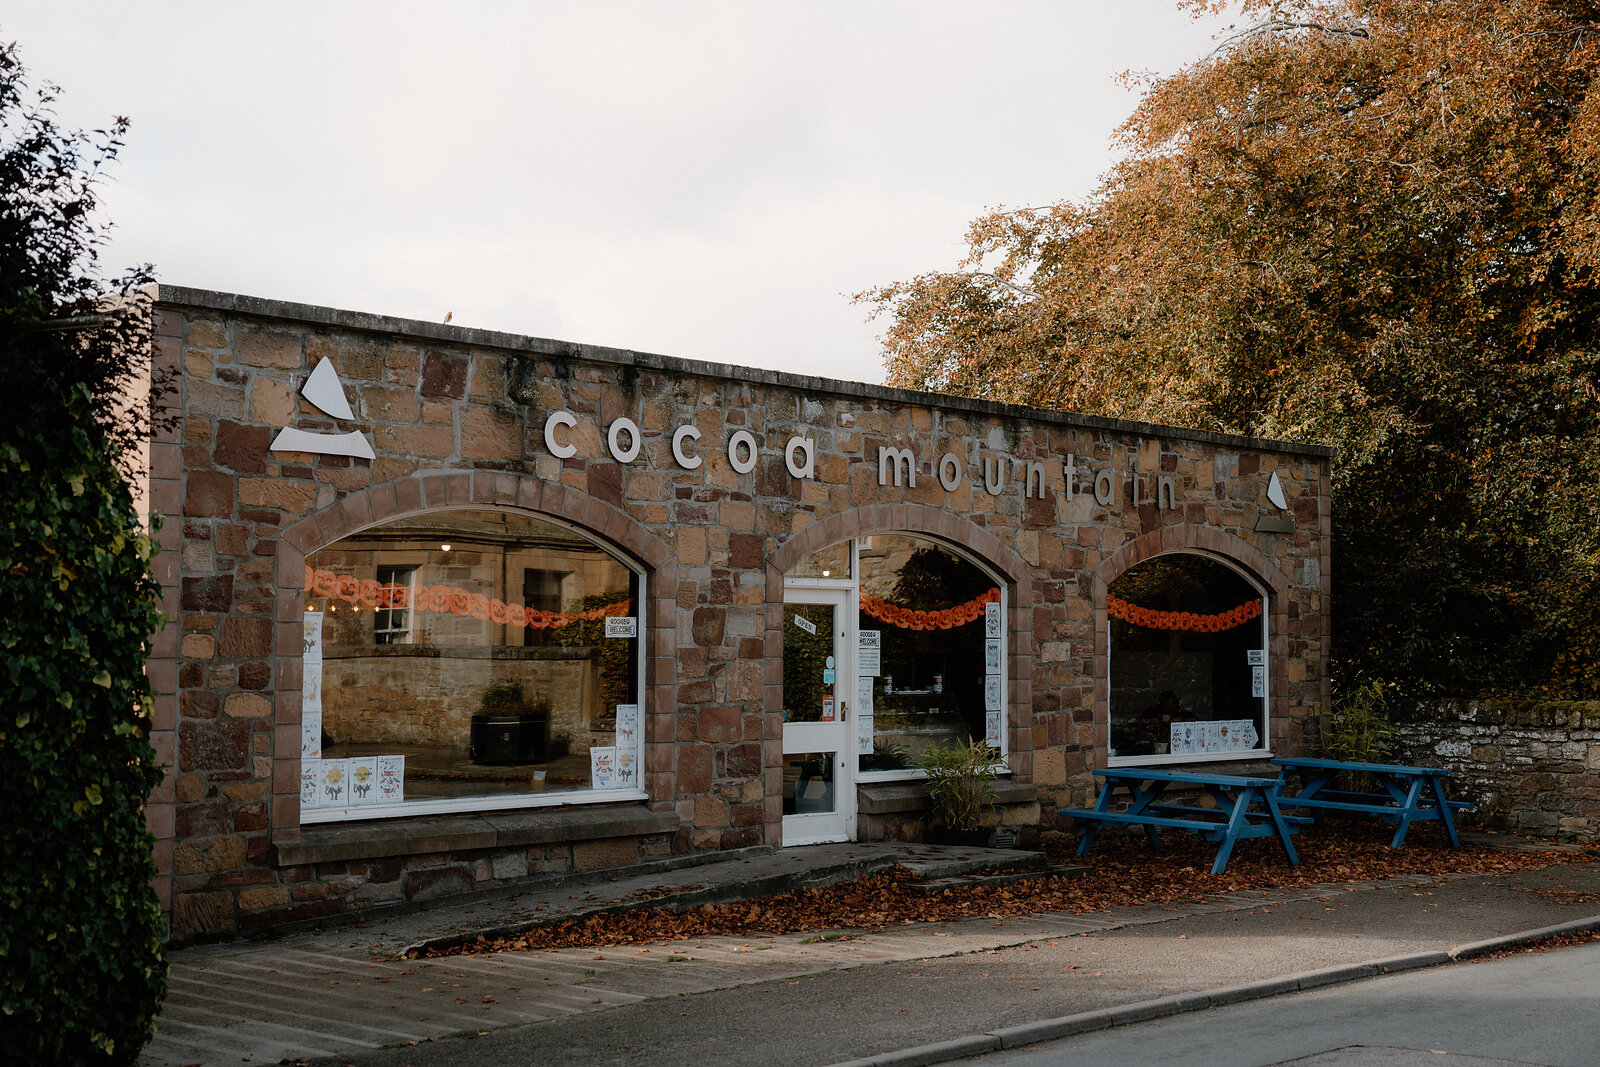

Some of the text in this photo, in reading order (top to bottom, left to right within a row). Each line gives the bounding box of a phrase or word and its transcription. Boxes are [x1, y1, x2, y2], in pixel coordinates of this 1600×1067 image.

[544, 411, 1176, 510] cocoa mountain
[798, 619, 812, 630] OPEN
